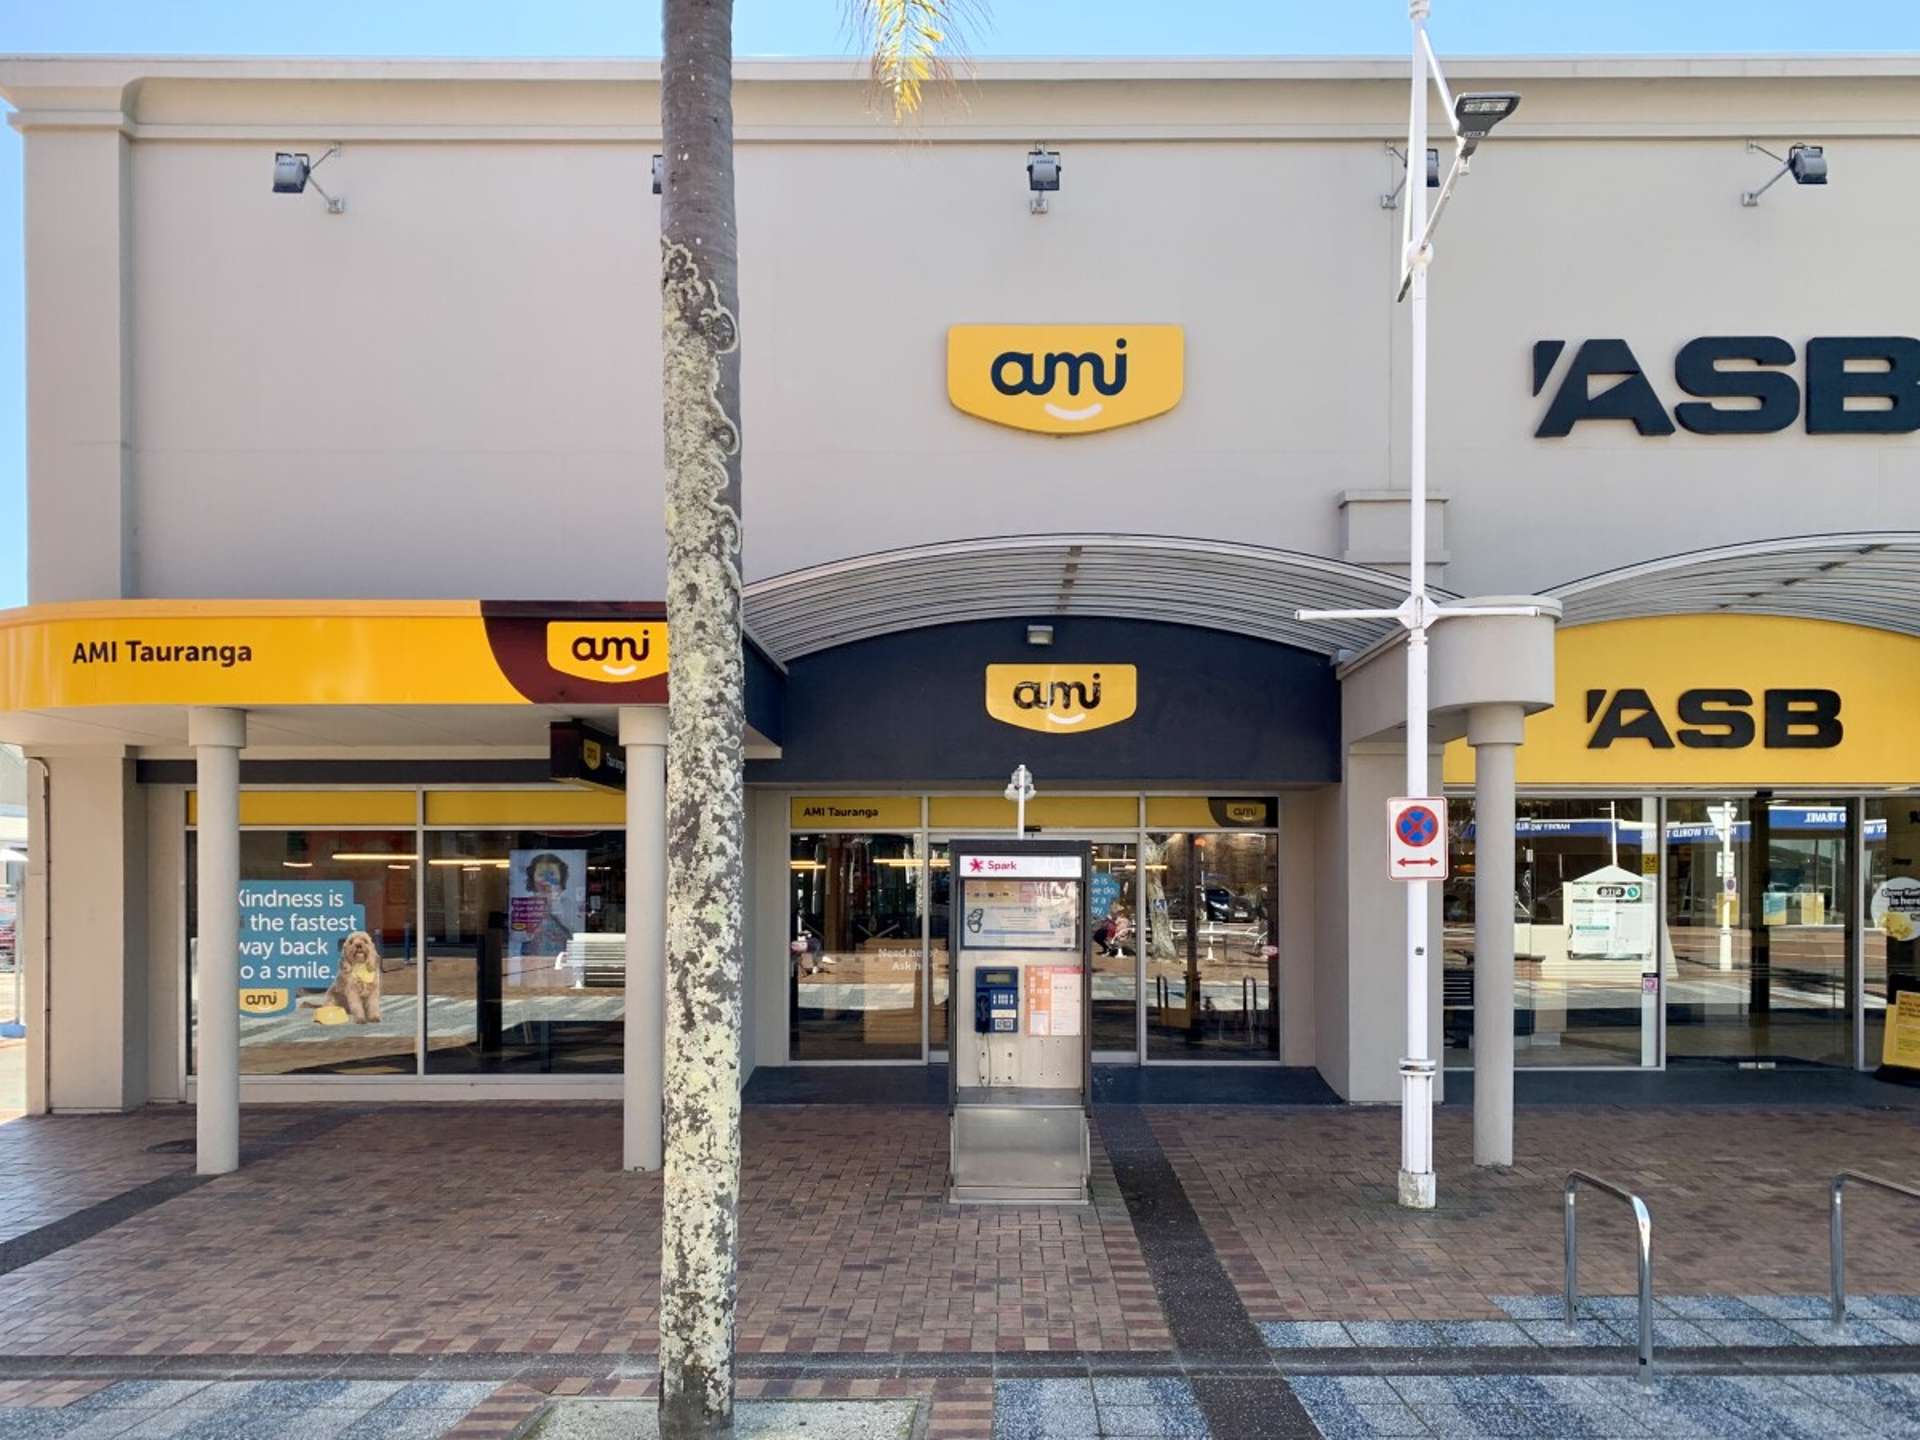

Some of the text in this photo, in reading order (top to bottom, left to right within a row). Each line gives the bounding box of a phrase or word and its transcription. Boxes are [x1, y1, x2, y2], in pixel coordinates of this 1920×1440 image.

[991, 338, 1128, 397] ami
[1533, 336, 1920, 438] ASB
[72, 640, 252, 667] AMI Tauranga
[571, 629, 650, 662] ami
[1013, 672, 1101, 710] ami
[1586, 689, 1844, 750] ASB
[803, 808, 880, 819] AMI Tauranga
[1233, 806, 1257, 817] ami
[988, 860, 1017, 872] Spark
[329, 889, 344, 908] is
[250, 913, 358, 932] the fastest
[280, 937, 329, 956] back
[878, 948, 906, 958] Need
[240, 961, 336, 980] o a smile.
[892, 961, 912, 971] Ask
[245, 992, 278, 1005] ami
